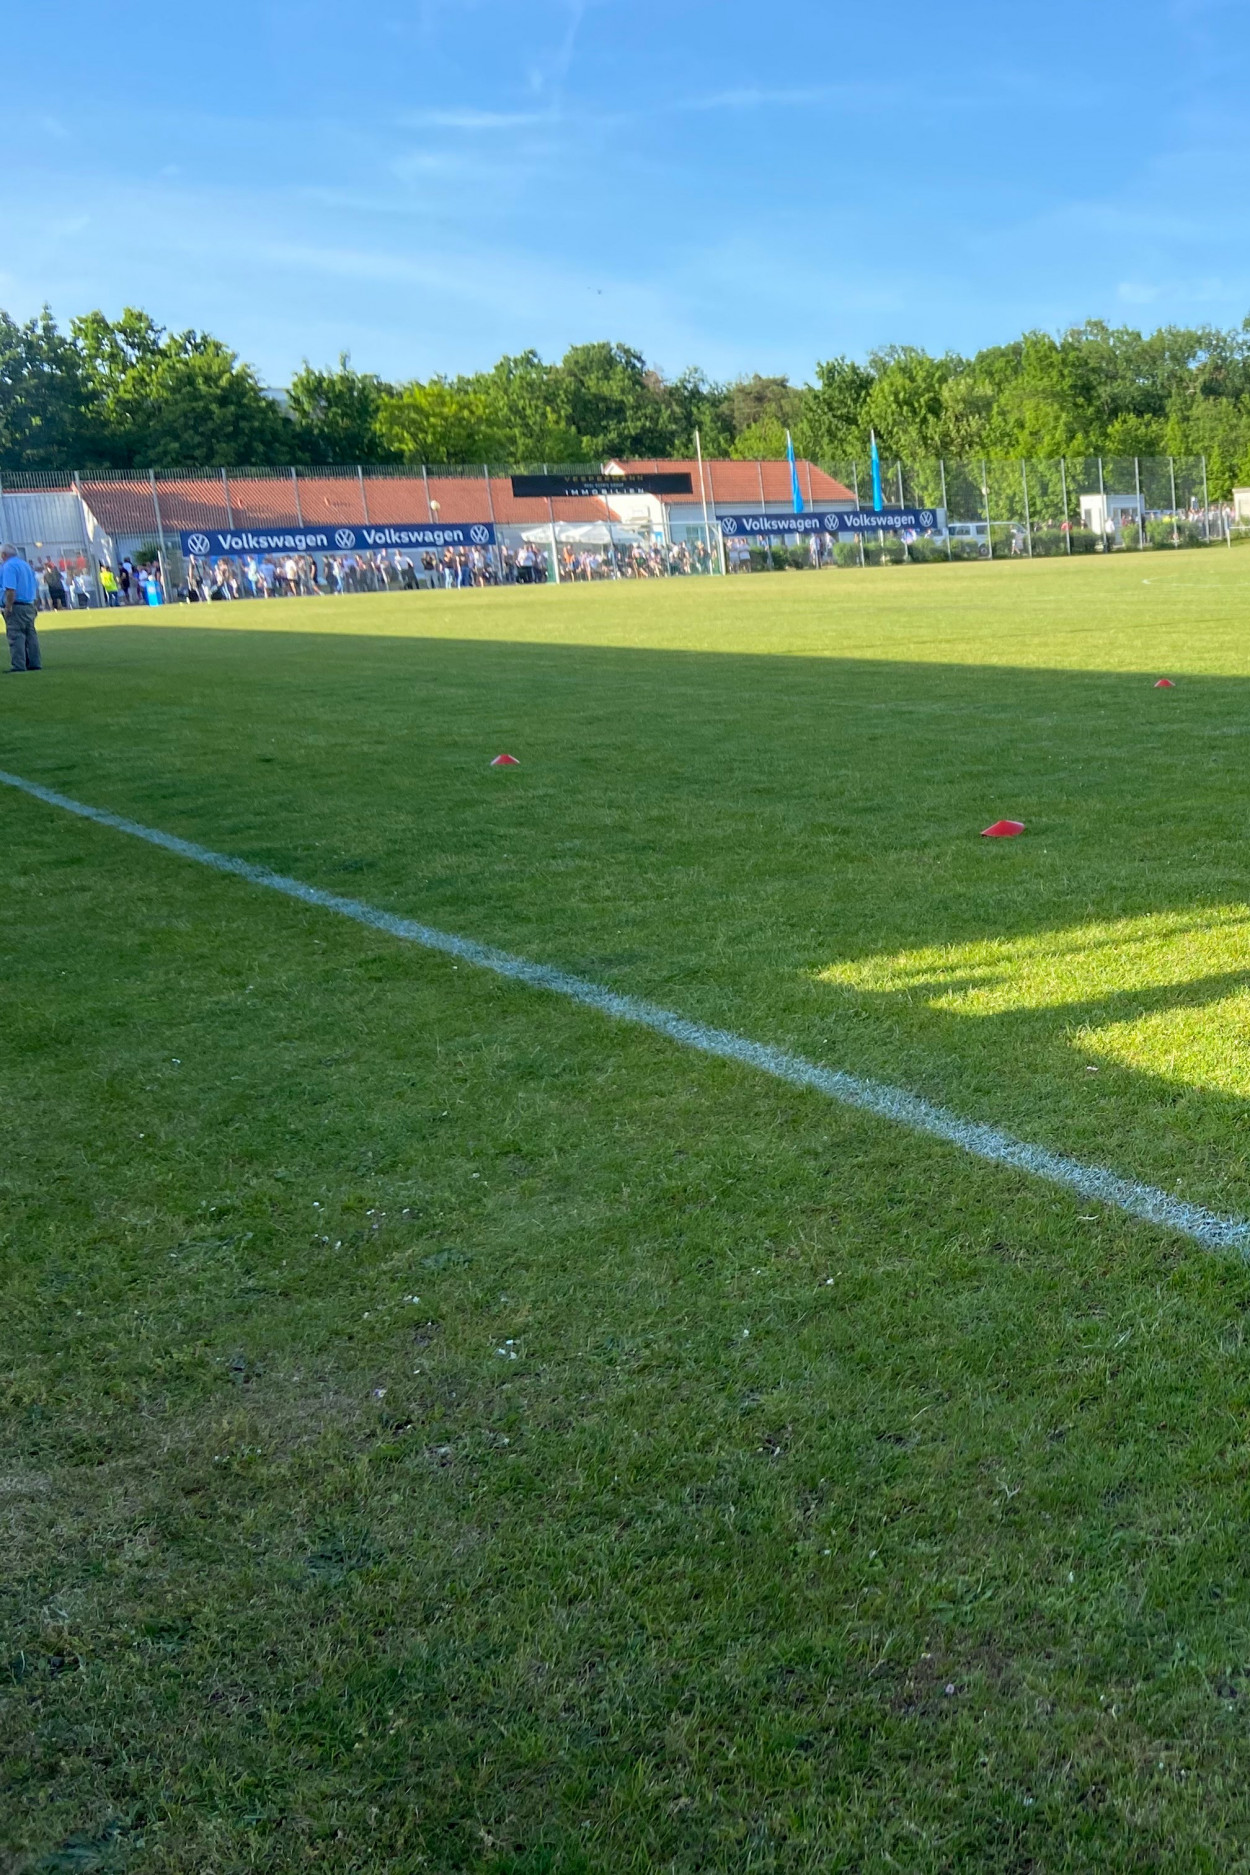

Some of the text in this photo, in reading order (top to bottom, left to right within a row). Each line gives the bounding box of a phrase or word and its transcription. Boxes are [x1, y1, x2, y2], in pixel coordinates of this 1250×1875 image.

[565, 487, 645, 496] IMMOBILIEN
[742, 516, 820, 532] Volkswagen
[844, 513, 915, 528] Volkswagen
[217, 532, 328, 551] Volkswagen
[362, 527, 464, 546] Volkswagen
